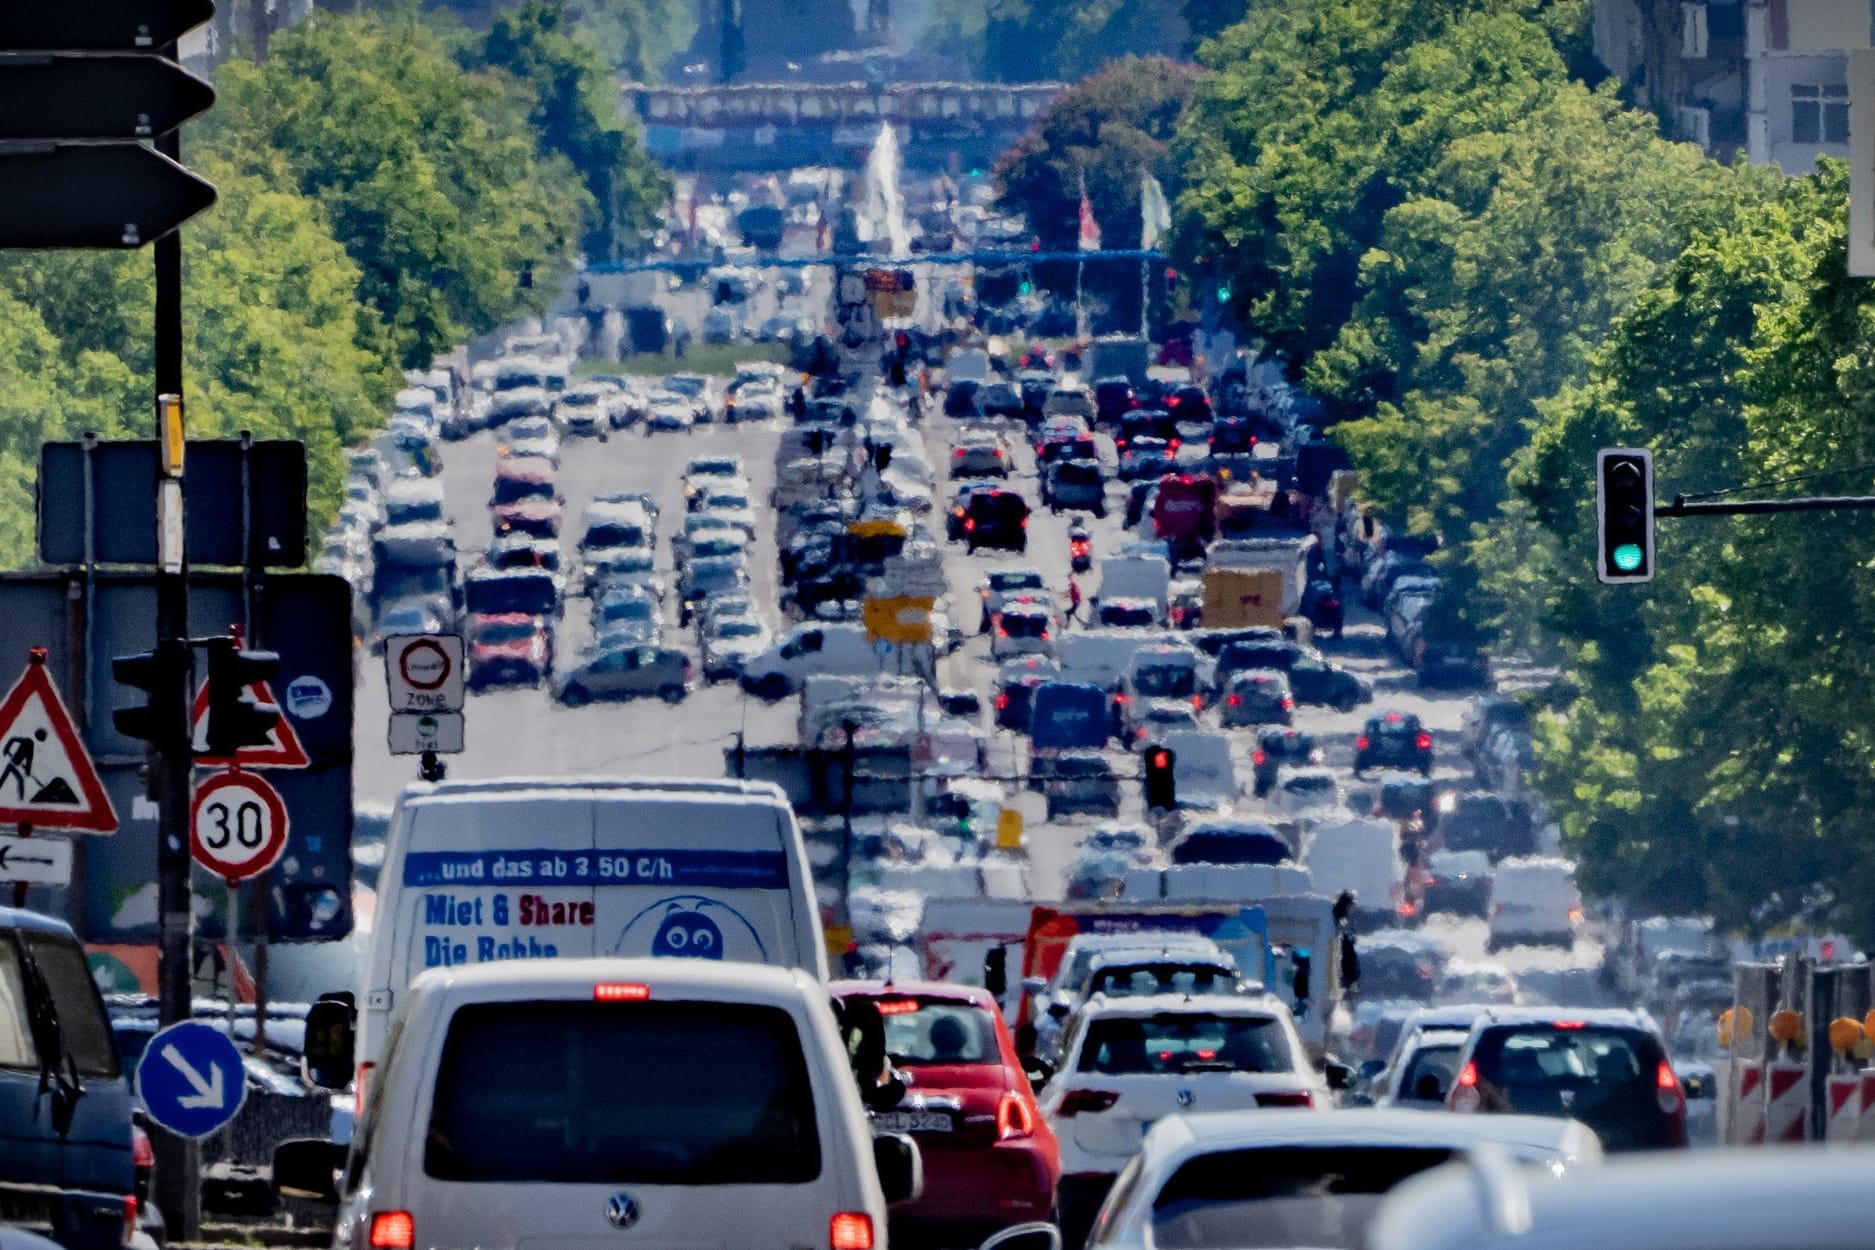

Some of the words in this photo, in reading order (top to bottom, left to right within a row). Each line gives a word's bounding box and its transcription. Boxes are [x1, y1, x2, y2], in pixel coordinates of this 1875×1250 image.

[206, 800, 263, 849] 30
[492, 856, 533, 878] das
[539, 856, 567, 878] ab
[425, 894, 483, 926] Miet
[492, 893, 510, 926] &
[519, 894, 595, 926] Share
[425, 935, 468, 967] Die
